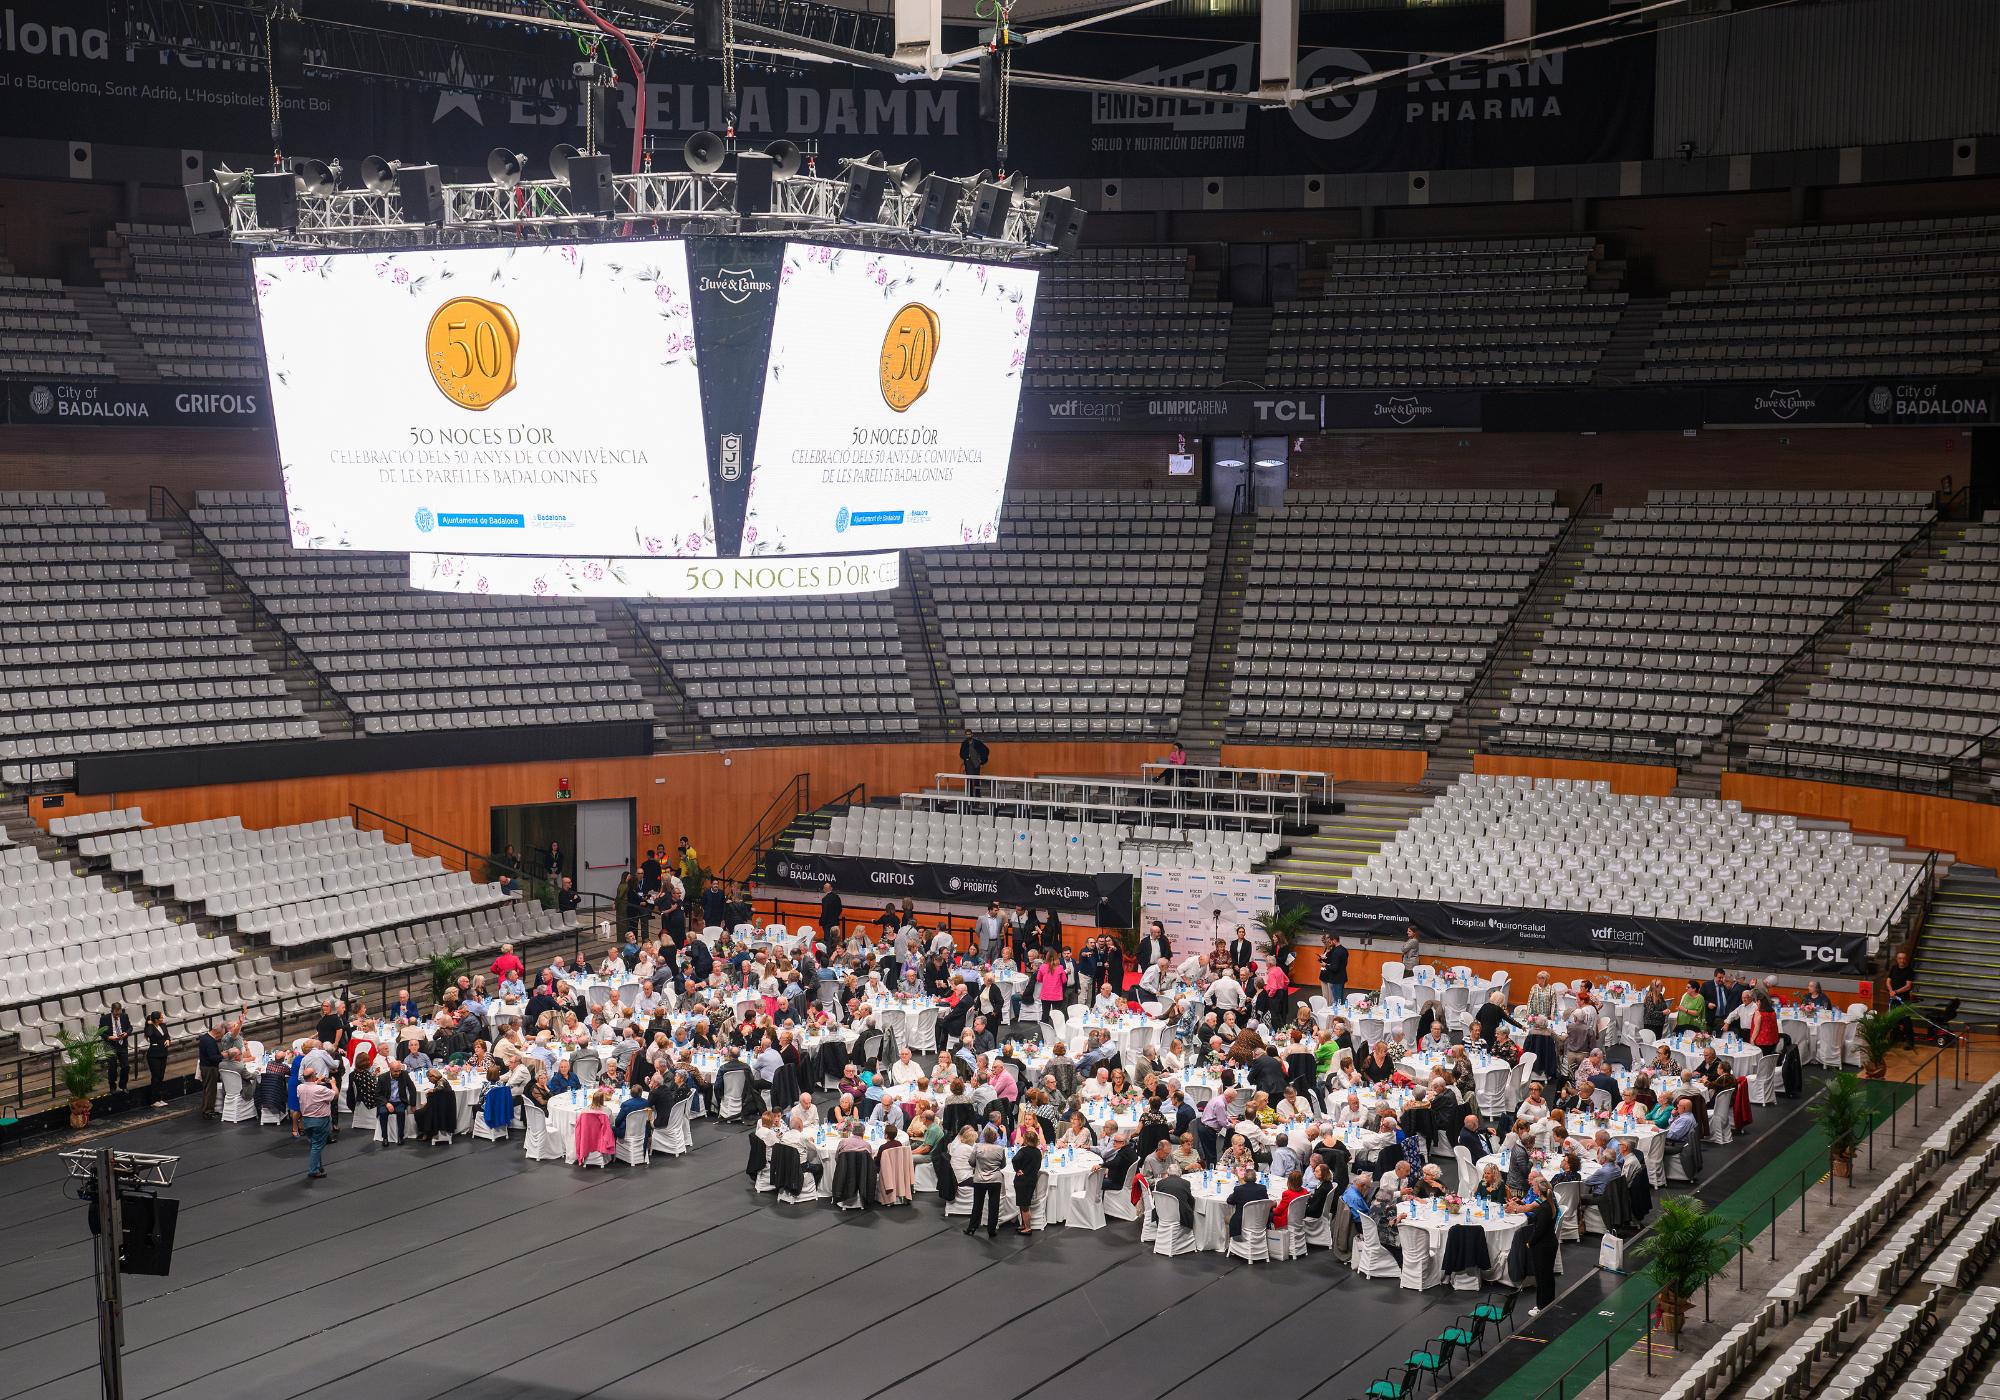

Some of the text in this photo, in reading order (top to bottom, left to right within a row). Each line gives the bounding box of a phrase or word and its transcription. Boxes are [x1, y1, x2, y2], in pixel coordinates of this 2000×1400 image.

[0, 8, 108, 61] lona
[1407, 51, 1565, 93] KERN
[14, 76, 23, 88] a
[27, 75, 101, 97] Barcelona,
[105, 81, 138, 97] Sant
[185, 89, 264, 108] L'Hospitalet
[308, 98, 331, 111] Boi
[786, 87, 959, 136] DAMM
[1406, 95, 1563, 123] PHARMA
[1091, 137, 1122, 152] SALUD
[1125, 137, 1134, 151] Y
[1190, 136, 1246, 151] DEPORTIVA
[448, 321, 501, 379] 50
[891, 326, 928, 381] 50
[57, 386, 98, 401] City of
[1897, 384, 1937, 400] City of
[58, 401, 149, 418] BADALONA
[175, 393, 256, 414] GRIFOLS
[1254, 400, 1316, 421] TCL
[1896, 399, 1988, 415] BADALONA
[410, 423, 555, 446] 50 NOCES D'OR
[852, 425, 938, 446] 50 NOCES D'OR
[417, 449, 450, 464] DELS
[453, 449, 469, 465] 50
[472, 449, 511, 464] ANYS
[514, 450, 534, 464] DE
[852, 449, 874, 464] DELS
[874, 449, 885, 465] 50
[886, 449, 910, 464] ANYS
[910, 449, 922, 464] DE
[379, 468, 398, 483] DE
[401, 468, 423, 483] LES
[493, 468, 599, 484] BADALONINES
[822, 468, 835, 484] DE
[442, 516, 480, 527] Ajuntament
[481, 517, 489, 525] de
[489, 517, 519, 526] Badalona
[686, 566, 724, 591] 50
[734, 567, 821, 590] NOCES
[828, 560, 870, 587] D'OR
[804, 863, 811, 871] of
[789, 870, 837, 883] BADALONA
[870, 871, 915, 886] GRIFOLS
[963, 881, 998, 894] PROBITAS
[1341, 910, 1409, 923] Barcelona Premium
[1451, 917, 1486, 929] Hospital
[1519, 931, 1546, 940] Badalona
[1800, 945, 1849, 963] TCL
